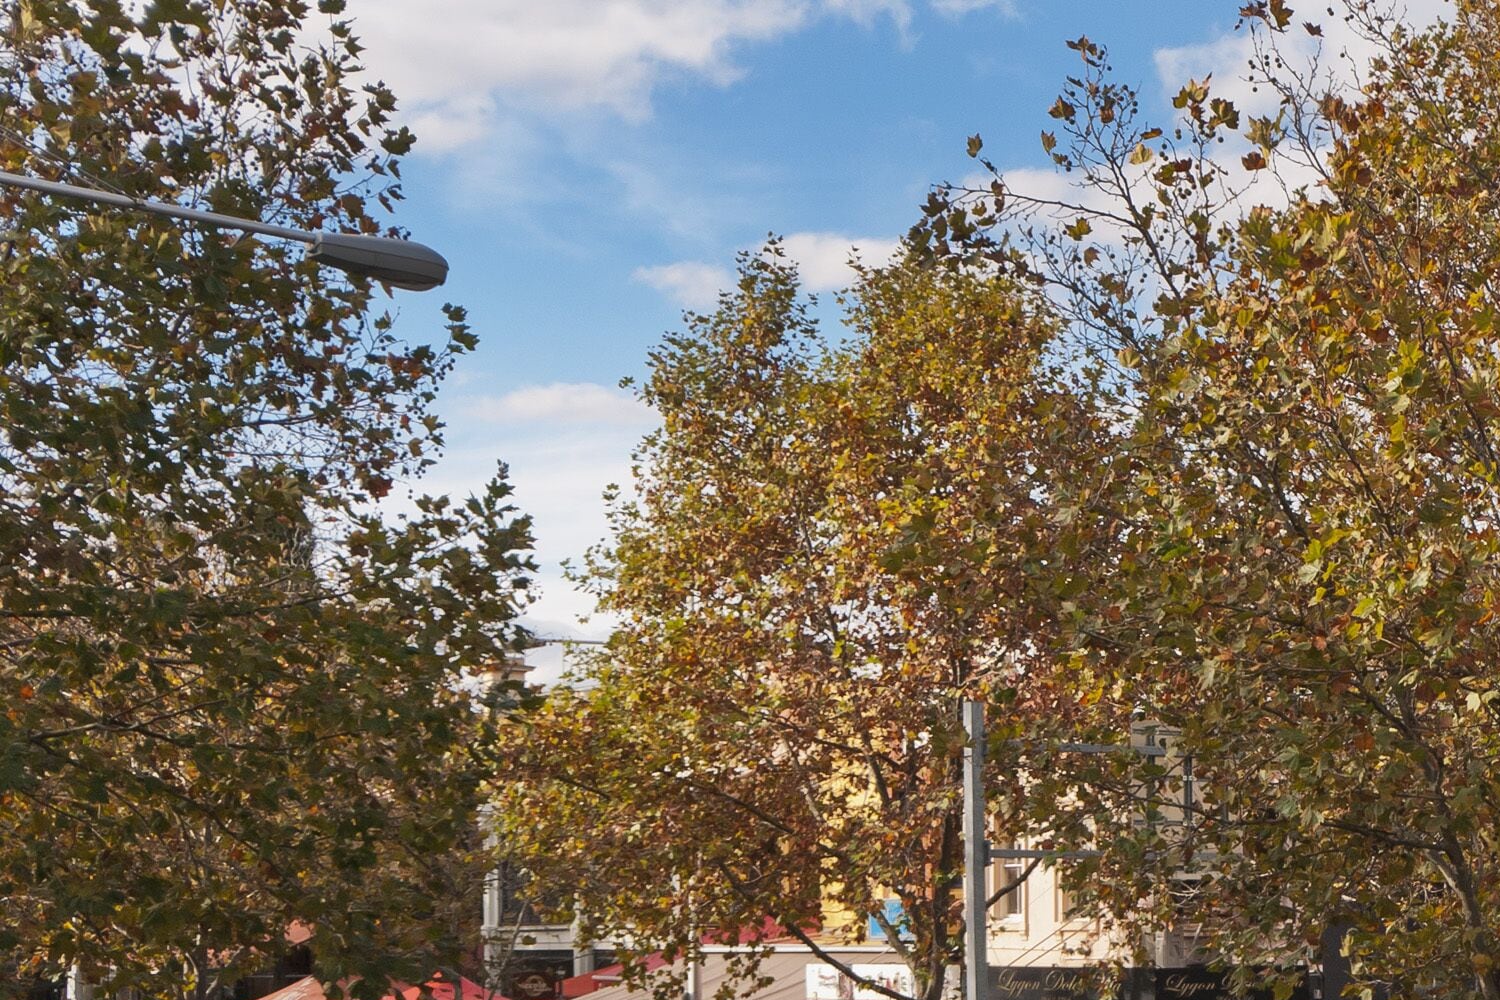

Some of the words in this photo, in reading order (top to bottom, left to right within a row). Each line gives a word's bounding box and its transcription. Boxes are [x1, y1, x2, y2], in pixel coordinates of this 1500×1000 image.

[997, 969, 1040, 998] Lygon
[1043, 969, 1081, 991] Dolc
[1164, 974, 1216, 998] Lygon
